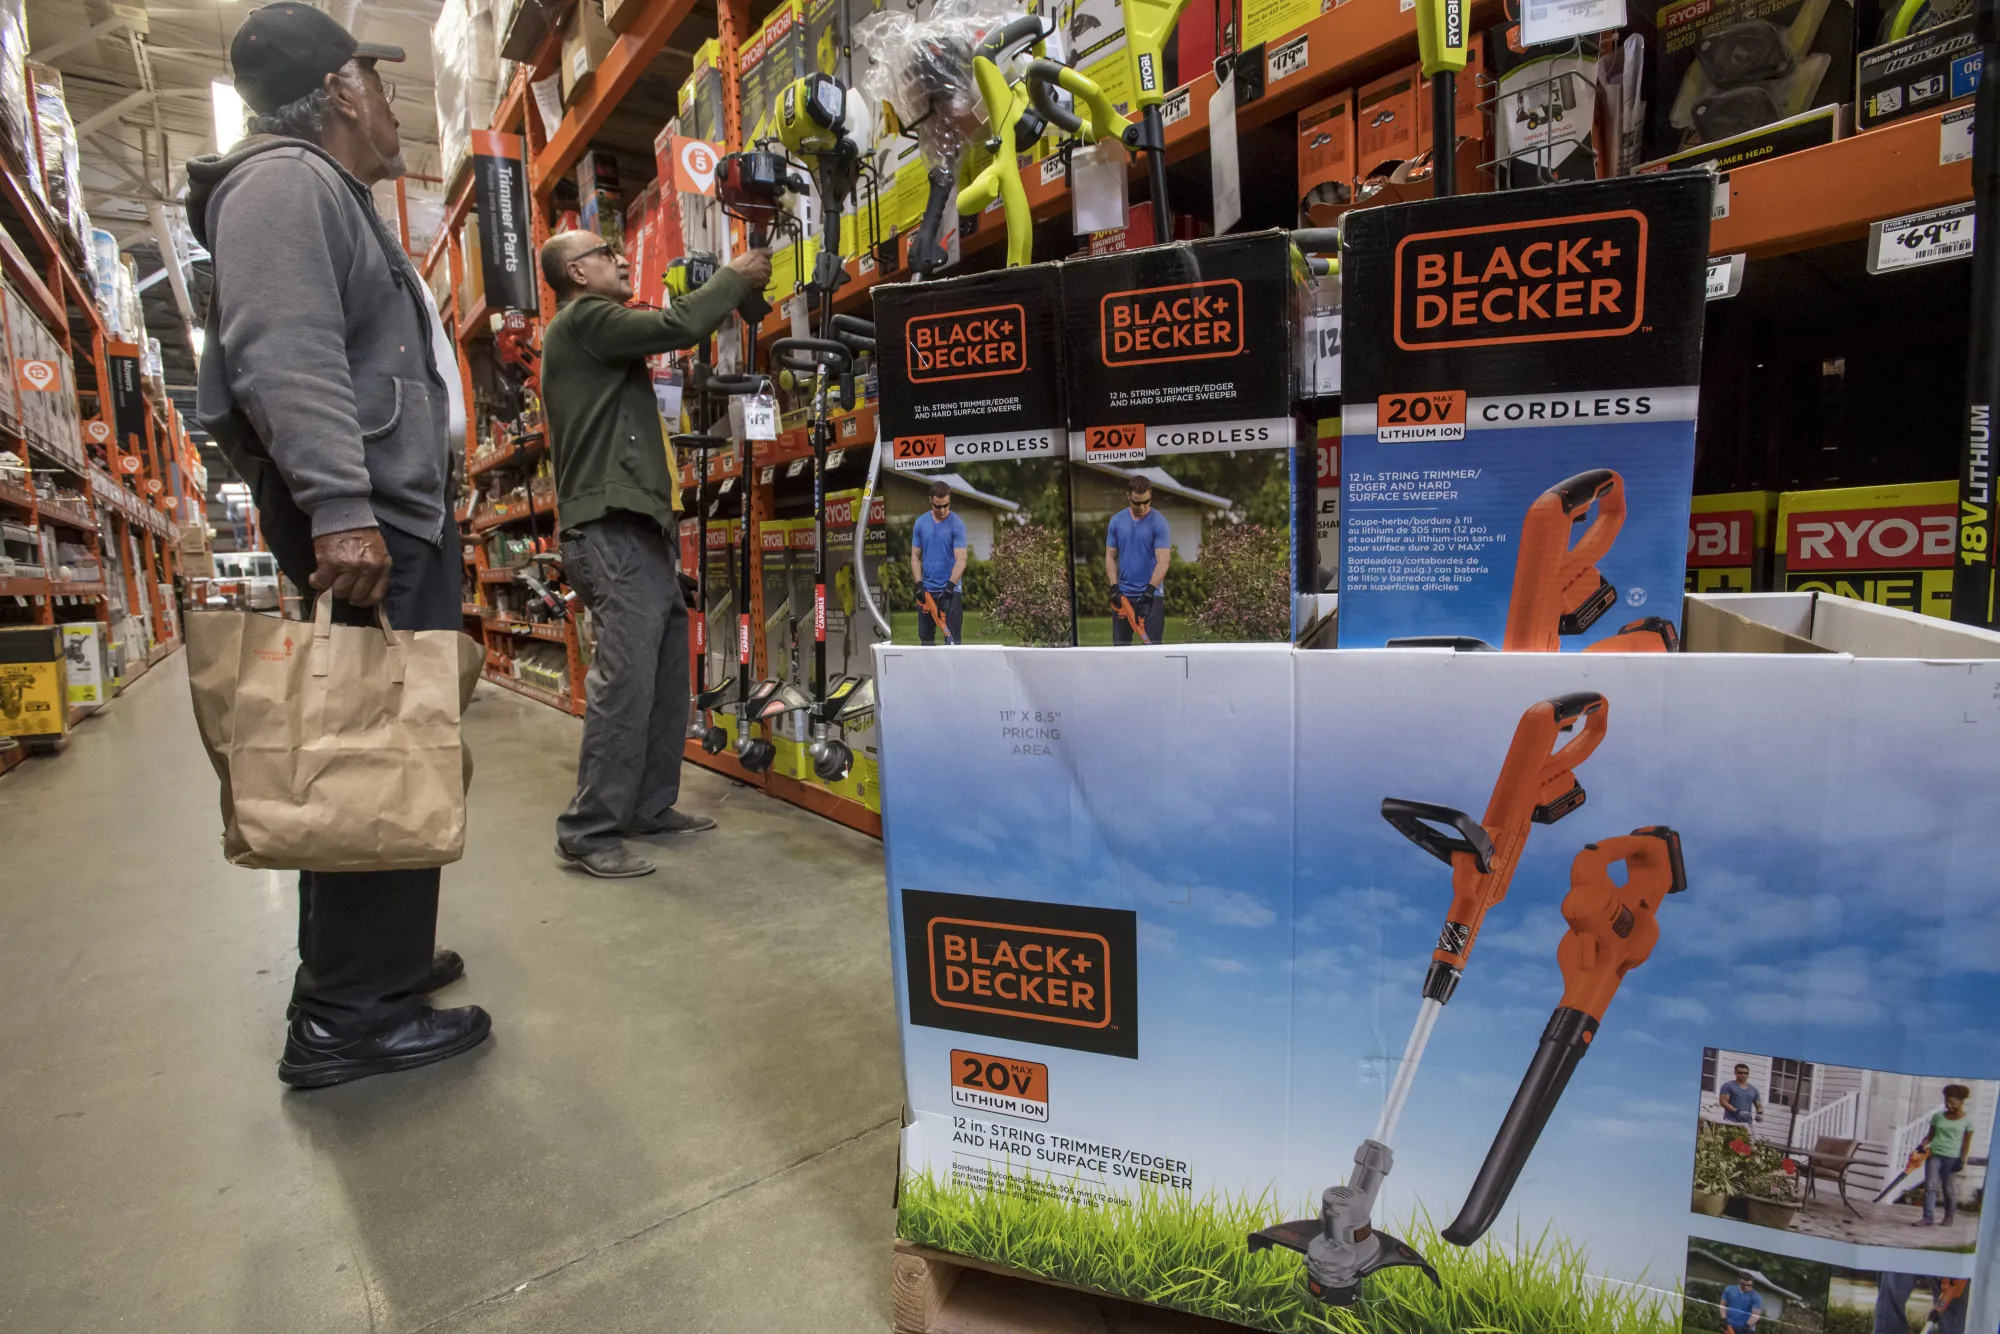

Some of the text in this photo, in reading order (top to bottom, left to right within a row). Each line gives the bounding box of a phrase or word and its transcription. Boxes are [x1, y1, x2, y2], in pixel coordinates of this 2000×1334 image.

[1448, 1, 1460, 46] RYOBI
[1668, 0, 1712, 26] RYOBI
[766, 9, 793, 45] RYOBI
[741, 40, 764, 72] RYOBI
[1140, 54, 1154, 91] RYOBI
[1745, 145, 1774, 159] HEAD
[695, 157, 707, 171] 5
[498, 166, 514, 231] Trimmer
[1092, 232, 1126, 249] ENGINEERED
[1115, 239, 1126, 250] OIL
[503, 231, 518, 273] Parts
[1416, 236, 1622, 290] BLACK+
[1112, 295, 1230, 328] BLACK+
[1415, 277, 1623, 329] DECKER
[915, 317, 1014, 349] BLACK+
[1113, 320, 1232, 354] DECKER
[916, 341, 1017, 372] DECKER
[123, 359, 135, 392] Mowers
[1109, 382, 1235, 400] 12 in. STRING TRIMMER/EDGER
[1110, 390, 1238, 407] AND HARD SURFACE SWEEPER
[914, 396, 1020, 413] 12 in. STRING TRIMMER/EDGER
[914, 403, 1022, 420] AND HARD SURFACE SWEEPER
[1386, 396, 1453, 425] 20V
[1482, 395, 1652, 422] CORDLESS
[1092, 428, 1137, 450] 20V
[1156, 426, 1270, 448] CORDLESS
[1380, 426, 1463, 441] LITHIUM ION
[899, 439, 937, 459] 20V
[954, 436, 1050, 456] CORDLESS
[1087, 449, 1145, 462] LITHIUM ION
[1969, 405, 1990, 503] LITHIUM
[896, 458, 945, 469] LITHIUM ION
[1349, 468, 1483, 482] 12 in. STRING TRIMMER/
[1349, 480, 1452, 492] EDGER AND HARD
[1349, 490, 1459, 502] SURFACE SWEEPER
[825, 502, 851, 525] RYOB
[1348, 516, 1473, 527] Coupe-herbe/bordure à fil
[762, 532, 785, 547] RYOBI
[826, 531, 853, 543] 2 CYCLE
[1348, 528, 1360, 536] au
[1361, 526, 1395, 535] lithium
[1396, 526, 1408, 534] de
[1411, 526, 1429, 534] 305
[1453, 525, 1468, 535] (12
[1469, 525, 1487, 535] po)
[1348, 534, 1507, 544] et souffleur au lithium-ion sans fil
[1796, 515, 1958, 560] RYOB
[1961, 500, 1988, 566] 18V
[1348, 543, 1456, 554] pour surface dure 20 V
[1347, 564, 1489, 575] 305 mm (12 pulg.) con batería
[1348, 556, 1479, 567] Bordeadora/cortabordes de
[1347, 574, 1473, 585] de litio y barredora de litio
[1347, 582, 1460, 593] para superficies difíciles
[1580, 606, 1600, 627] LITHIUM
[1021, 711, 1030, 723] X
[1002, 727, 1061, 740] PRICING
[1012, 744, 1052, 756] AREA
[944, 934, 1092, 976] BLACK+
[946, 965, 1096, 1012] DECKER
[962, 1057, 1033, 1096] 20V
[955, 1090, 1045, 1117] LITHIUM ION
[952, 1116, 1188, 1175] 12 in. STRING TRIMMER/EDGER
[952, 1131, 1193, 1191] AND HARD SURFACE SWEEPER
[952, 1162, 1133, 1208] Bordeadora/cortabordes de 305 mm pulg.)
[952, 1171, 1070, 1202] con de litio barredora
[952, 1178, 1011, 1198] para superficies
